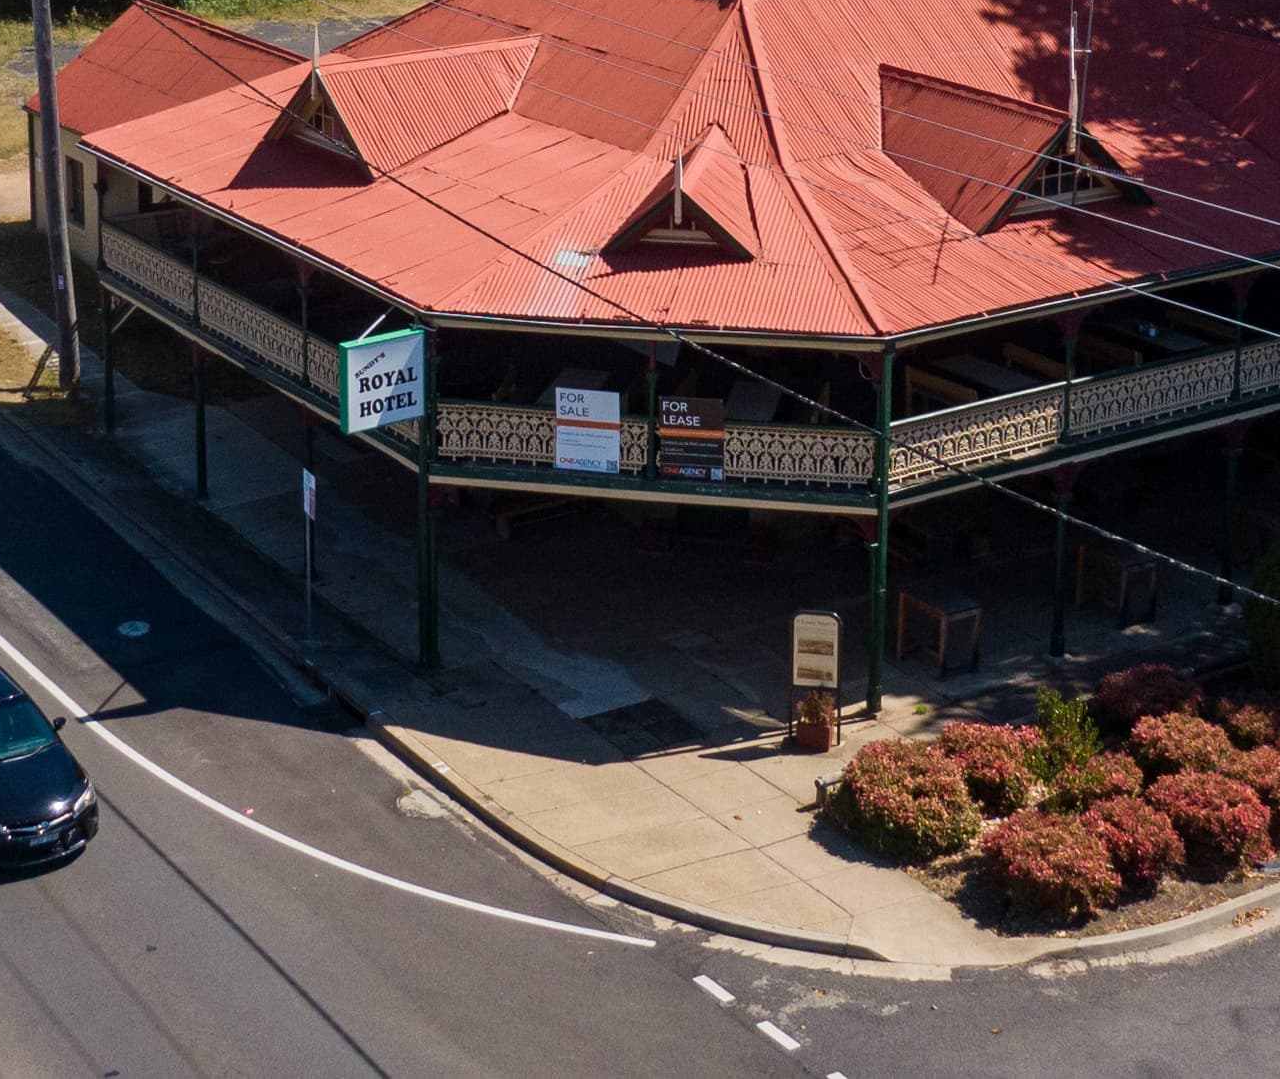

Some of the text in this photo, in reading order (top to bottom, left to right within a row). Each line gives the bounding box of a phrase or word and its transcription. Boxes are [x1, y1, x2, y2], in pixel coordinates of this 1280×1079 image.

[354, 352, 386, 378] BUNDY'S
[359, 367, 418, 393] ROYAL
[560, 392, 585, 403] FOR
[359, 391, 417, 418] HOTEL
[560, 405, 589, 417] SALE
[662, 401, 688, 412] FOR
[663, 414, 701, 427] LEASE
